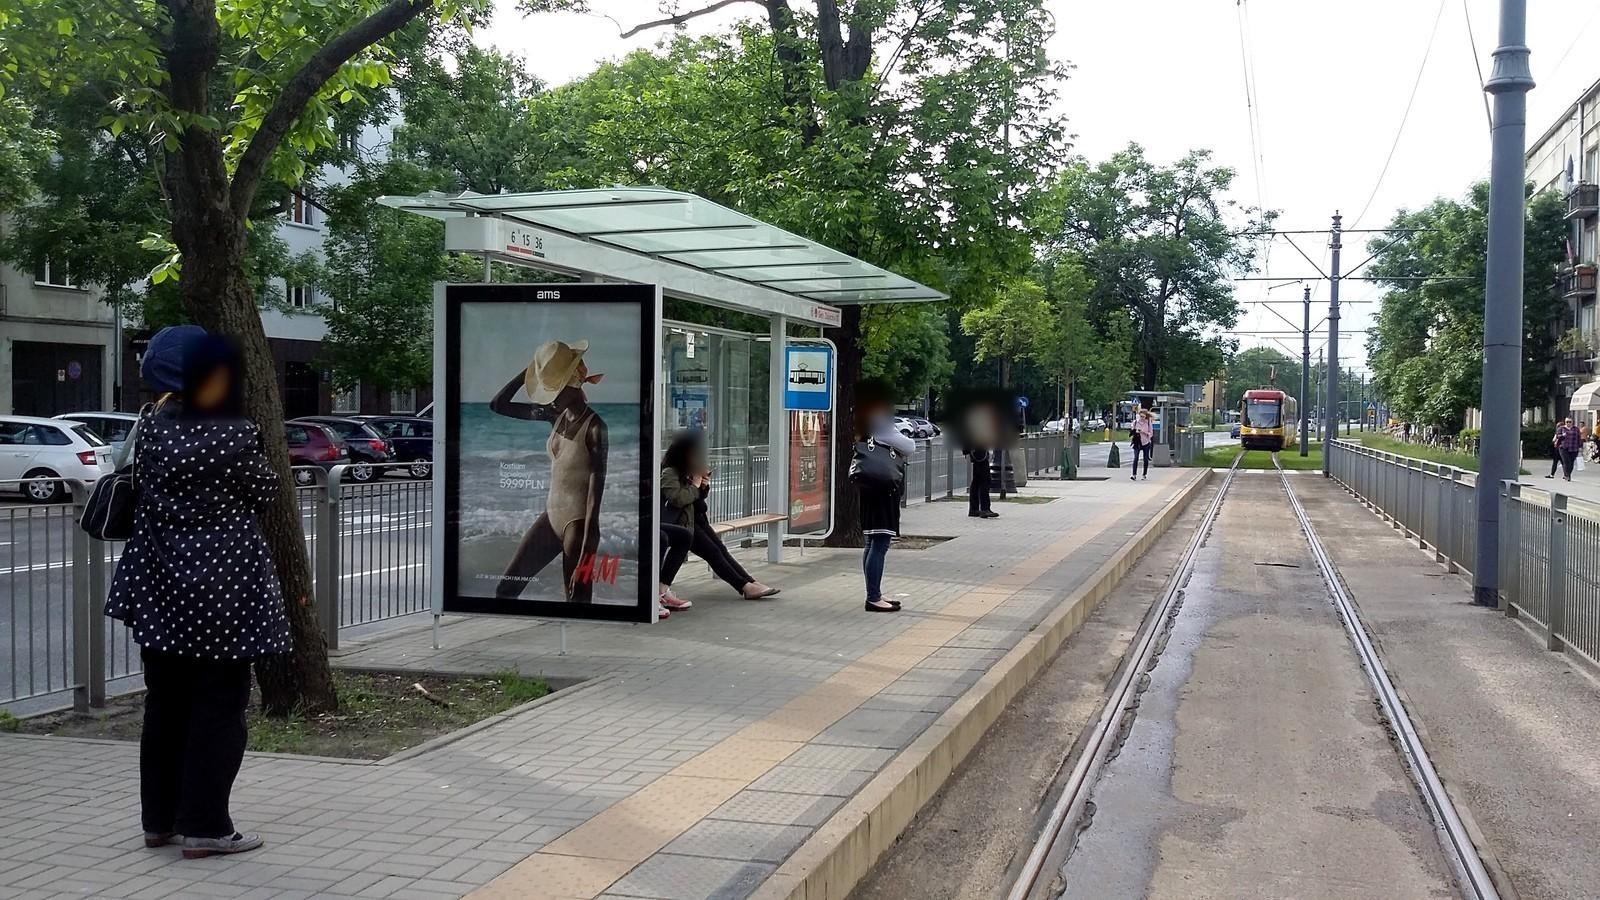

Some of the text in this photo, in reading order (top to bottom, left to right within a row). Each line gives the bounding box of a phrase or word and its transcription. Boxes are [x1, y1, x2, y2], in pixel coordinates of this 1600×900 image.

[511, 231, 543, 249] 6 15 36
[536, 290, 561, 299] ams
